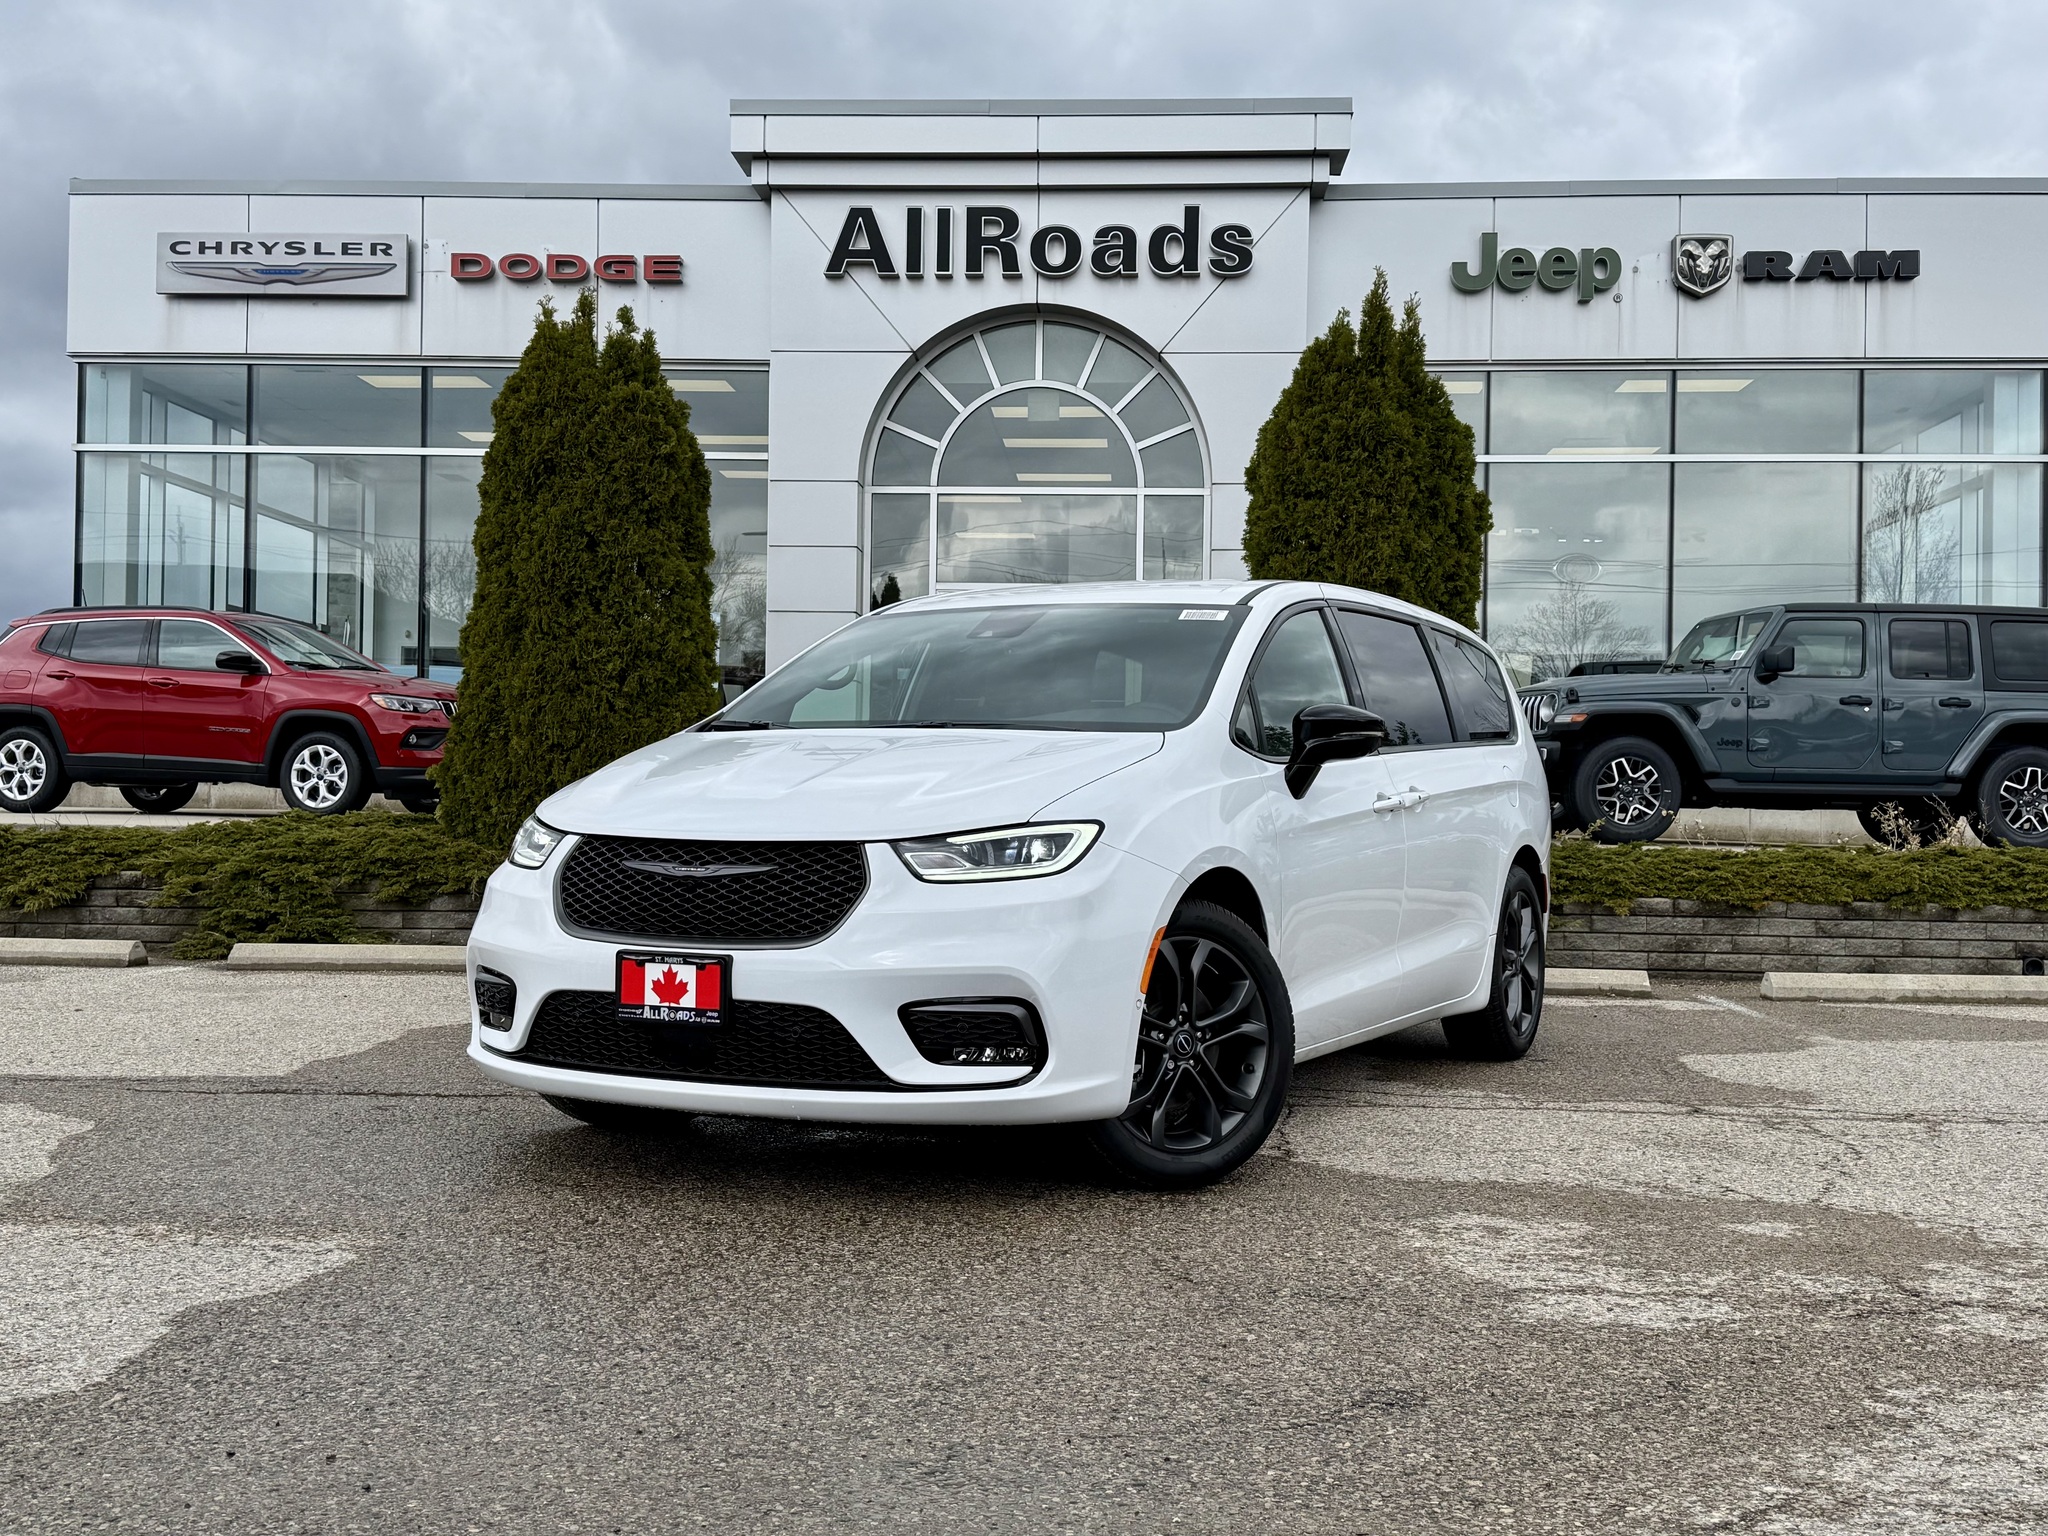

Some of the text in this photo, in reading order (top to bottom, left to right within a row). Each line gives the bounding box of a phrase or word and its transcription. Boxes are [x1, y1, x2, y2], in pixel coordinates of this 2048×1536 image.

[168, 240, 394, 257] CHRYSLER
[823, 203, 1255, 279] AllRoads
[450, 252, 684, 285] DODGE
[1743, 249, 1921, 282] RAM
